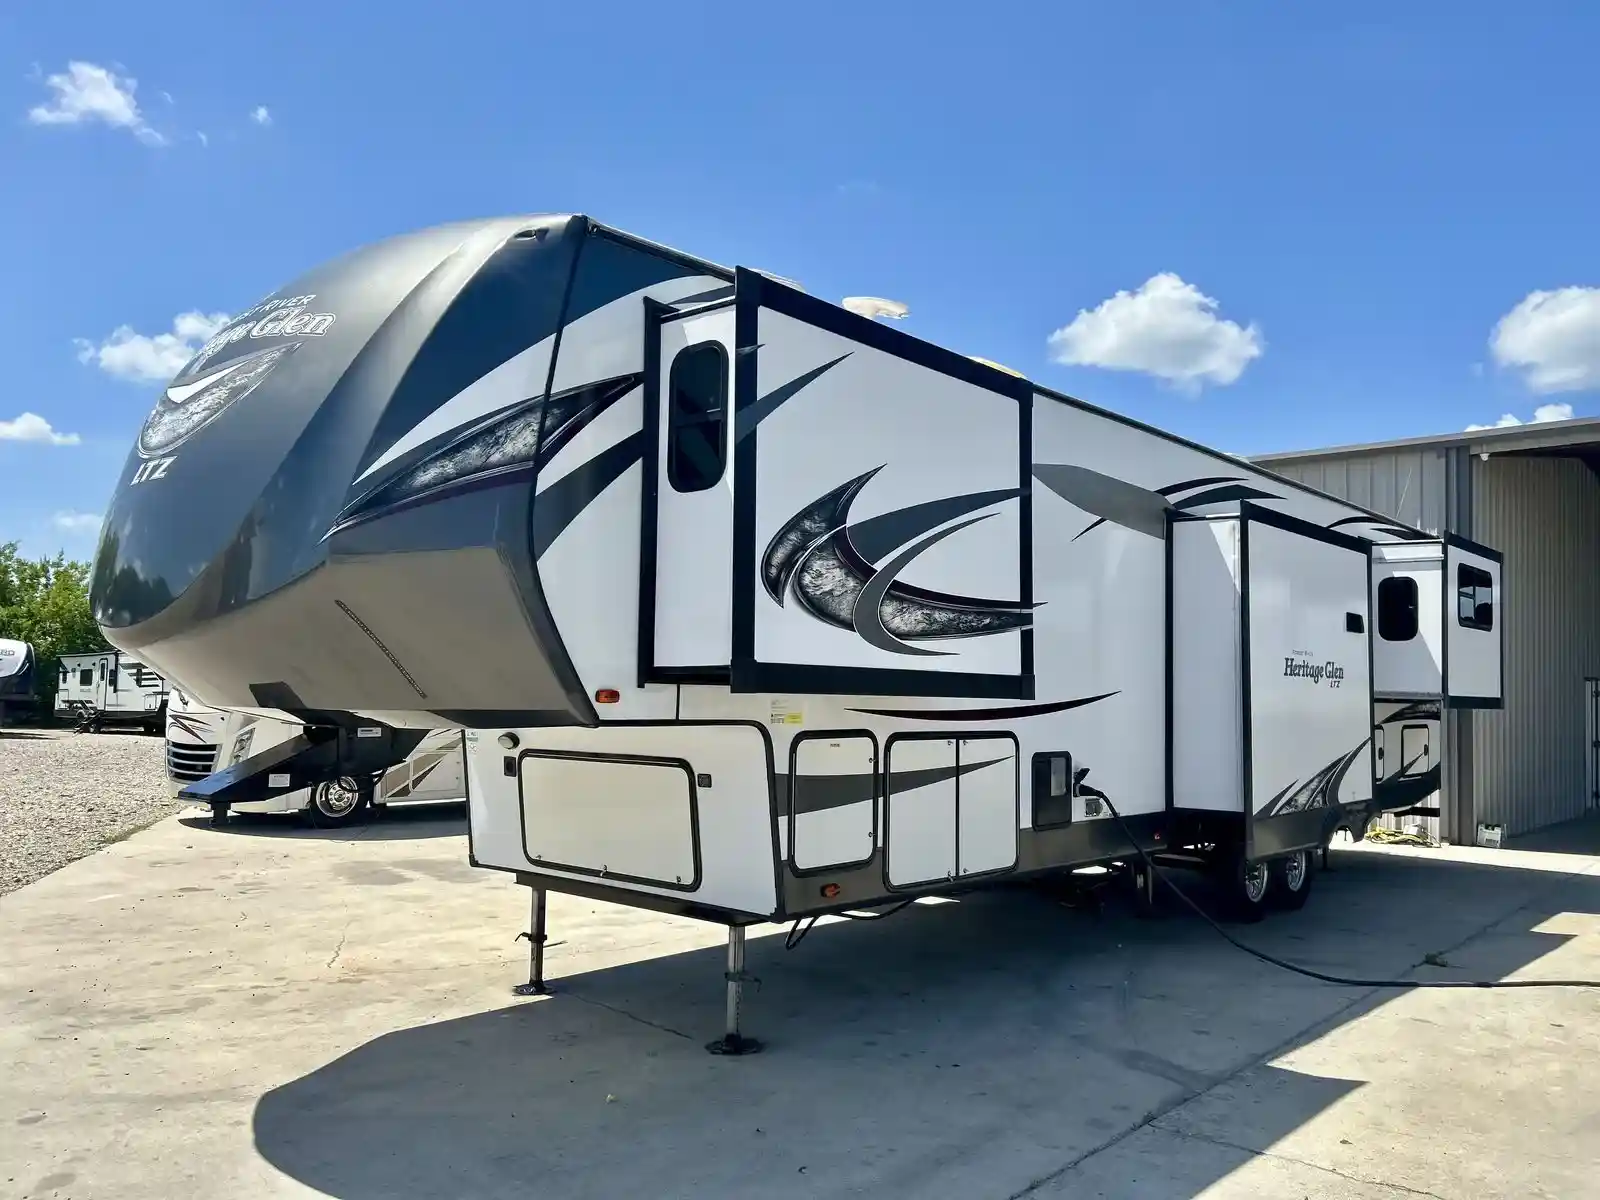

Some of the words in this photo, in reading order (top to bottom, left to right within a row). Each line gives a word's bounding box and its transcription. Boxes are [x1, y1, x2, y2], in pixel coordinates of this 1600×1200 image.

[259, 294, 317, 313] RIVER
[249, 304, 336, 339] Glen
[129, 455, 178, 487] LTZ
[1283, 657, 1324, 684] Heritage
[1324, 661, 1344, 679] Glen
